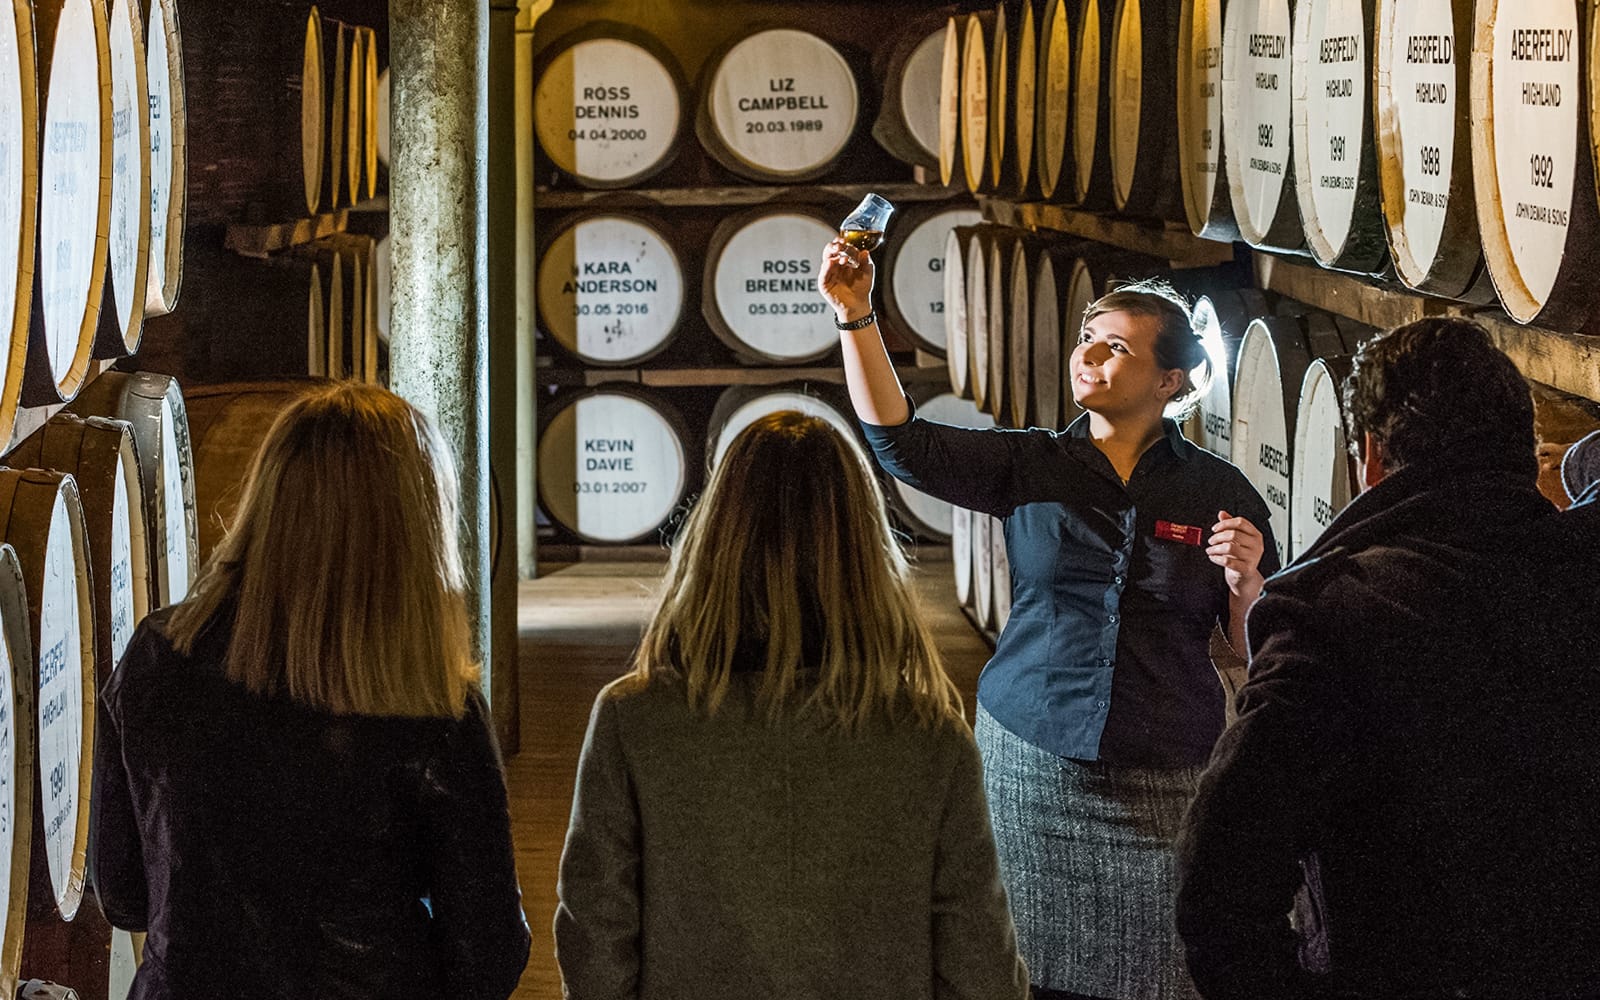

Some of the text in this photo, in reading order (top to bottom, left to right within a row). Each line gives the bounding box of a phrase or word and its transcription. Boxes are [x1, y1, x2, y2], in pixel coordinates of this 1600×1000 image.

[1249, 34, 1285, 59] ABERFELDY
[1318, 34, 1359, 64] ABERFELDY
[1512, 29, 1572, 62] ABERFELDY
[769, 78, 795, 92] LIZ
[1255, 72, 1278, 91] HIGHLAND
[1326, 78, 1352, 98] HIGHLAND
[583, 86, 630, 101] ROSS
[1416, 82, 1446, 104] HIGHLAND
[1522, 82, 1561, 107] HIGHLAND
[575, 105, 639, 119] DENNIS
[738, 96, 828, 112] CAMPBELL
[745, 120, 823, 133] 20.03.1989
[1258, 123, 1273, 148] 1992
[1330, 136, 1346, 161] 1991
[1420, 146, 1440, 176] 1988
[1530, 154, 1553, 188] 1992
[584, 261, 632, 275] KARA
[763, 259, 811, 274] ROSS
[562, 280, 657, 294] ANDERSON
[745, 279, 818, 293] BREMNE
[749, 303, 827, 315] 05.03.2007
[585, 439, 634, 452] KEVIN
[586, 458, 634, 471] DAVIE
[1259, 443, 1289, 479] ABERFELD
